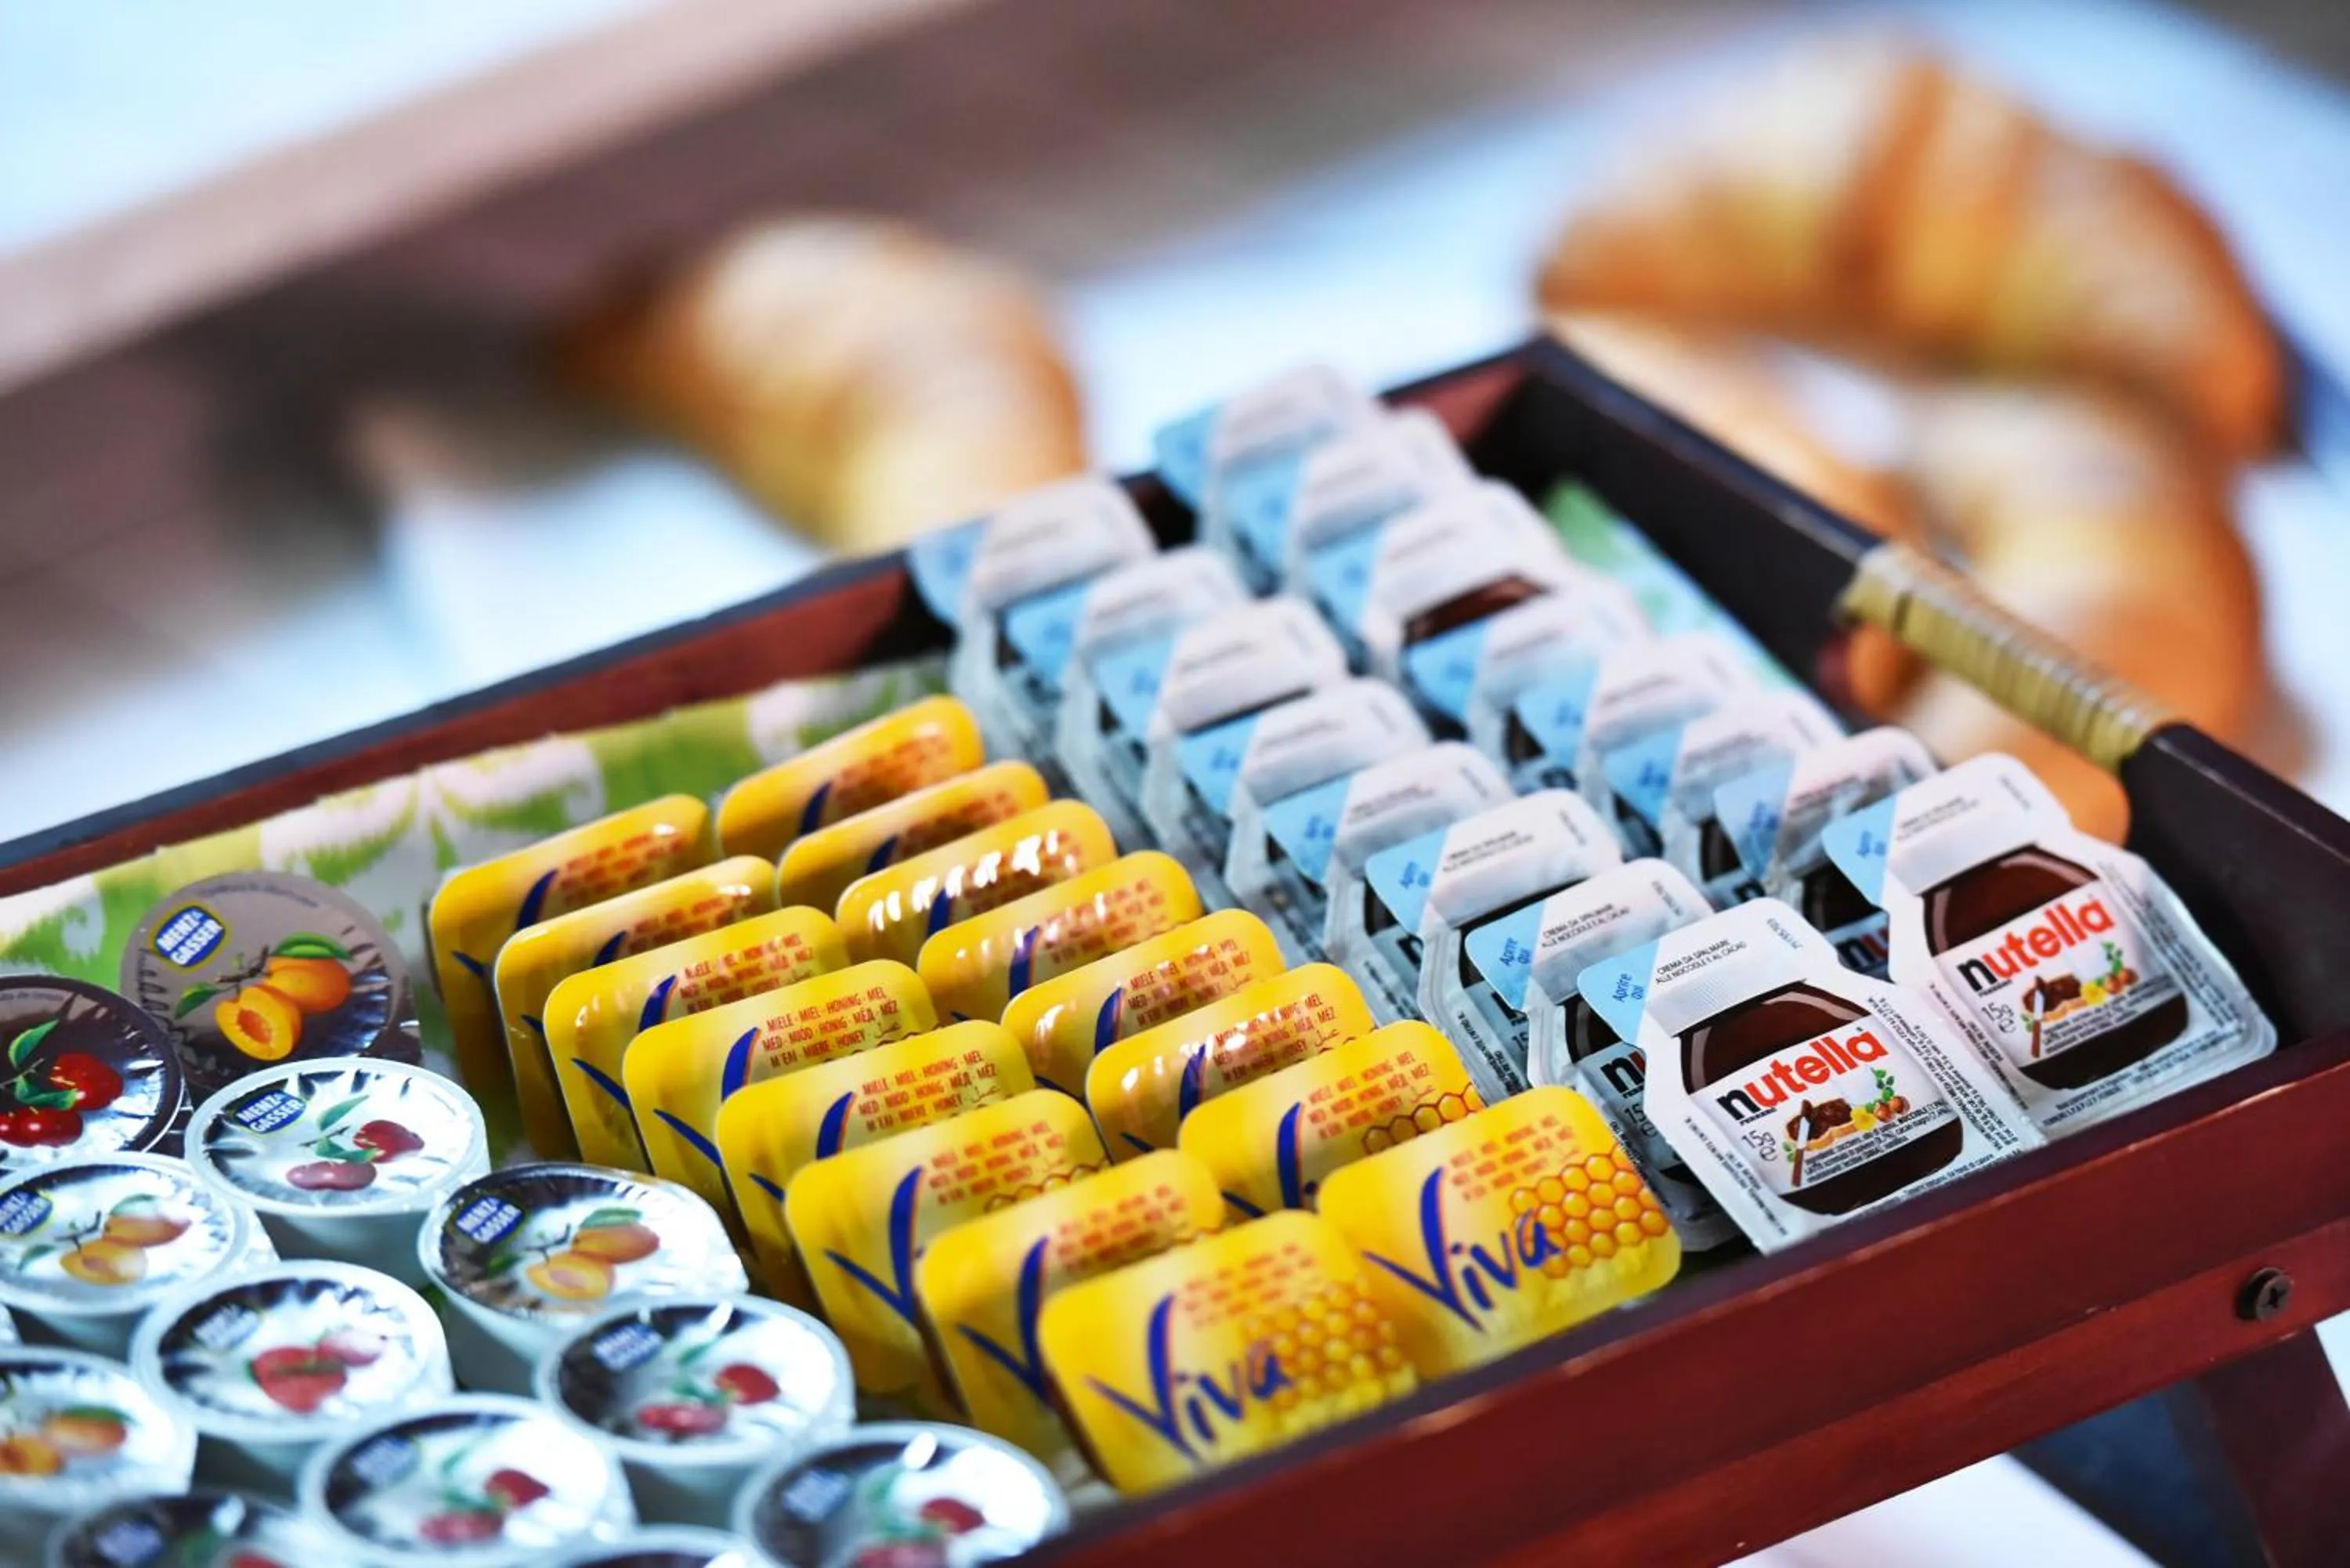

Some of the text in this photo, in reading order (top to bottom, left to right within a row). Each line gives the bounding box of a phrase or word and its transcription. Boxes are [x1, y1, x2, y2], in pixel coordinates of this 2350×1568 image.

[170, 919, 223, 966] GASSER
[1956, 898, 2115, 992] nutella
[766, 1013, 794, 1031] MIELE
[798, 1006, 821, 1021] MIEL
[867, 987, 886, 1002] MEL
[1716, 1030, 1889, 1121] nutella
[250, 1099, 304, 1132] GASSER
[1741, 1129, 1776, 1149] 15g
[1362, 1167, 1564, 1331] Viva
[1086, 1292, 1292, 1463] Viva
